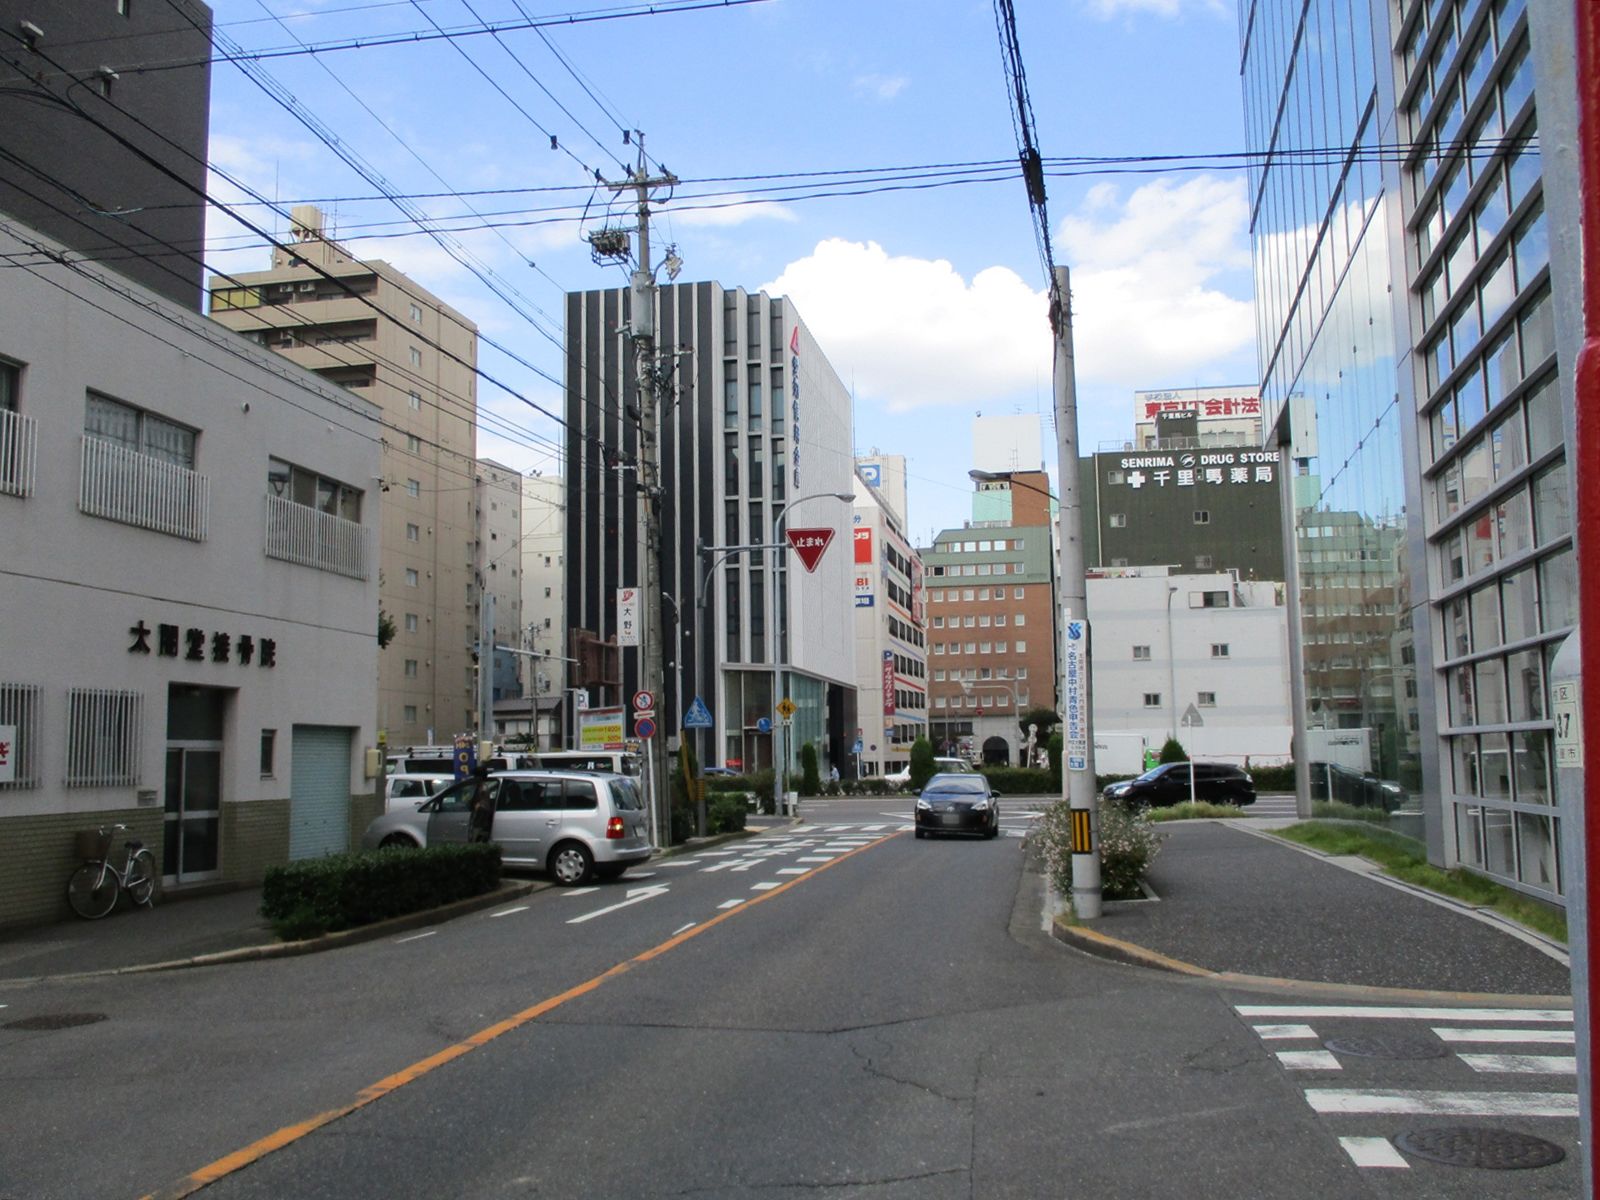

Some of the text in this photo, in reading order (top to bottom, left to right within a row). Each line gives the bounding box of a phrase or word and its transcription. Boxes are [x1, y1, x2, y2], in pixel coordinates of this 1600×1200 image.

[1145, 397, 1261, 419] 東京IT会計法
[1121, 451, 1279, 469] SENRIMA DRUG STORE
[1153, 466, 1273, 487] 千里馬薬局
[796, 536, 824, 547] 止まれ
